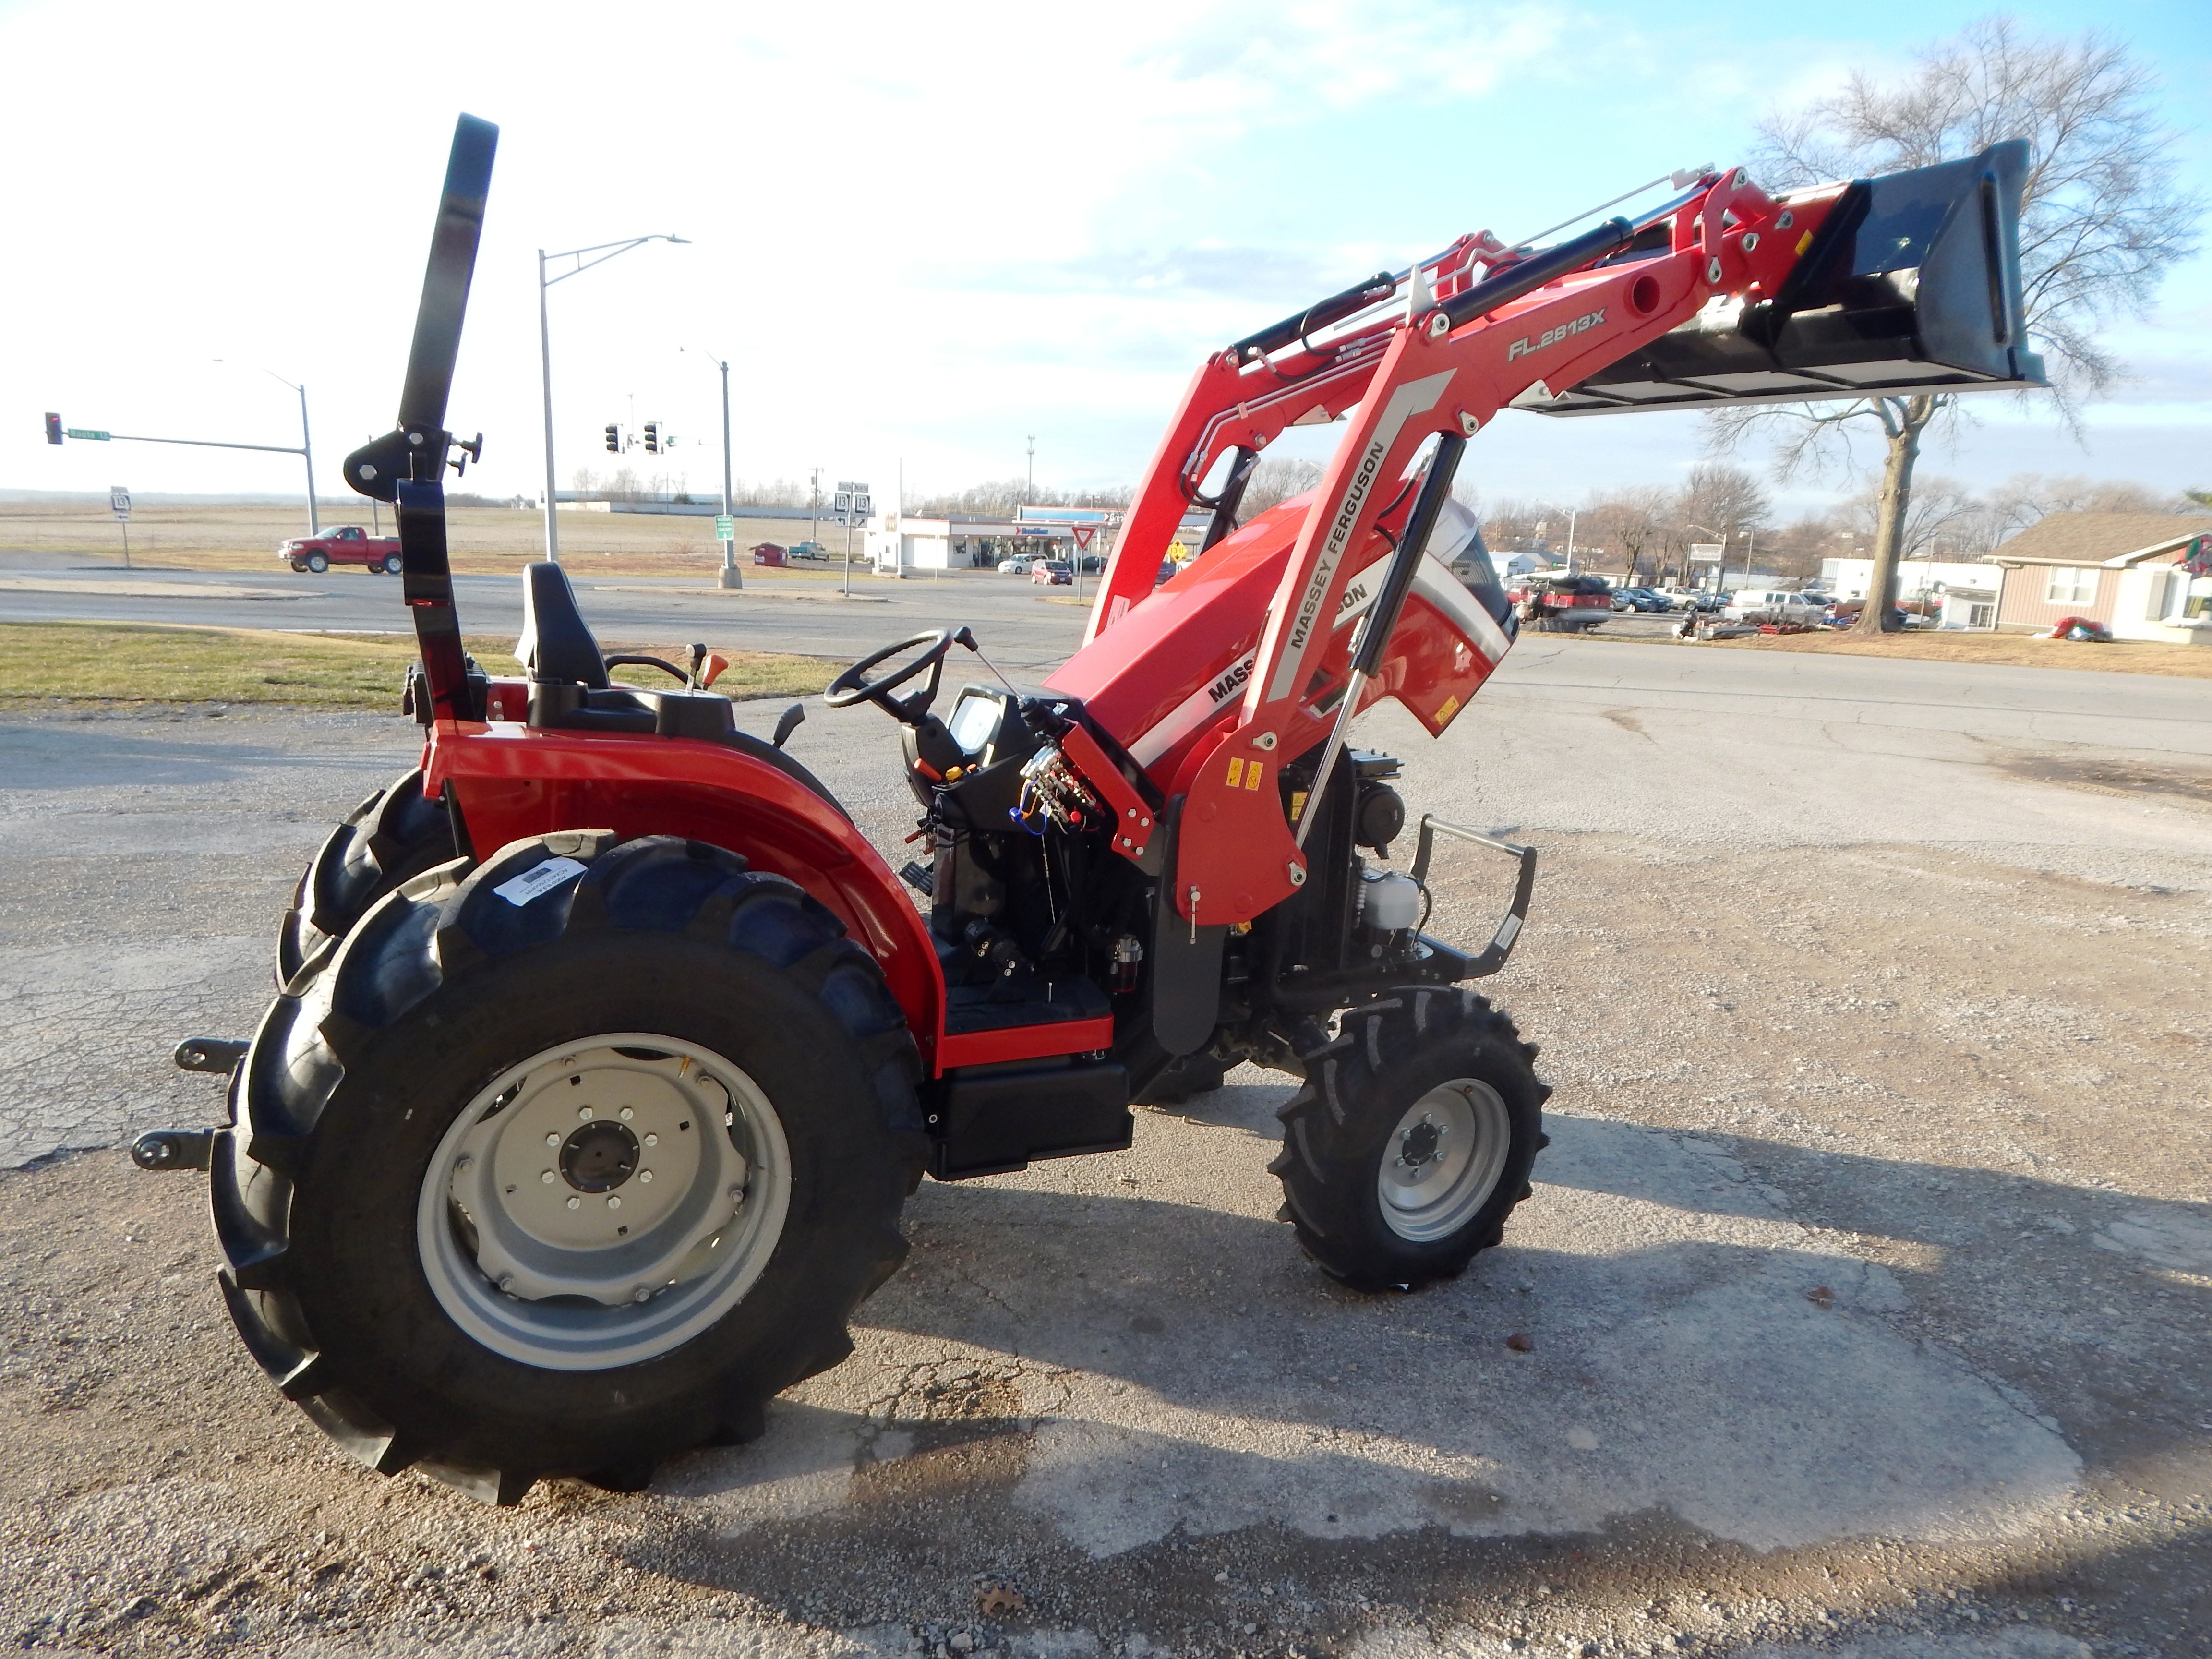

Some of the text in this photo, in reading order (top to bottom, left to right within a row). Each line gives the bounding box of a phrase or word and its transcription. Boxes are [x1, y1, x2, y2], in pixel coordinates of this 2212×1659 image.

[1508, 308, 1607, 362] FL.2813X
[70, 430, 95, 439] Route
[117, 497, 126, 506] 13
[839, 496, 846, 507] 13
[859, 497, 866, 508] 13
[1291, 441, 1384, 649] MASSEY FERGUSON
[1207, 655, 1255, 703] MASS
